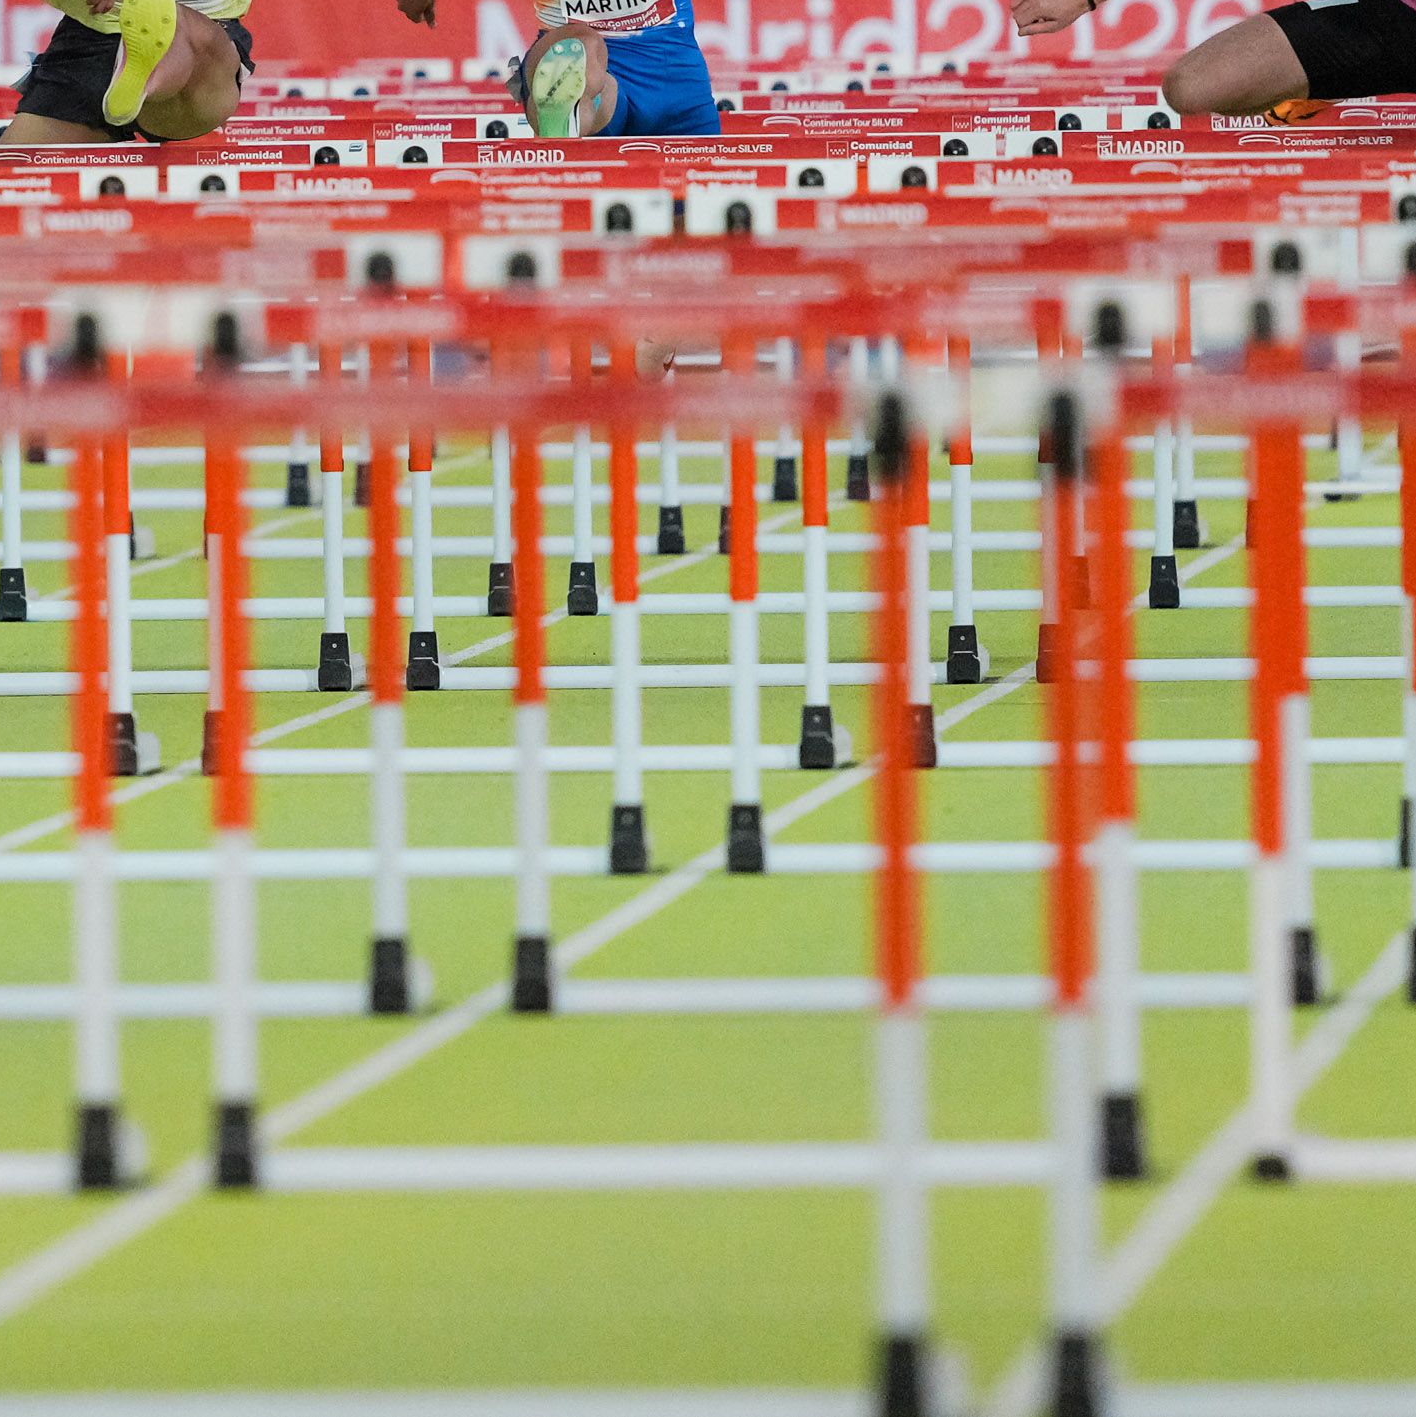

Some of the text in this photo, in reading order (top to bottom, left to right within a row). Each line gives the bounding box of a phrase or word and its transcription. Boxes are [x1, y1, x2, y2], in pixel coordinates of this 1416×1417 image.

[803, 118, 903, 128] Continental Tour SILVER
[974, 116, 1030, 124] Comunidad
[1229, 116, 1265, 127] MAD
[224, 126, 324, 135] Continental Tour SILVER
[395, 123, 451, 132] Comunidad
[851, 141, 912, 150] Comunidad
[1117, 141, 1184, 155] MADRID
[1283, 137, 1393, 148] Continental Tour SILVER
[663, 144, 772, 155] Continental Tour SILVER
[34, 154, 143, 165] Continental Tour SILVER
[221, 151, 283, 160] Comunidad
[497, 149, 564, 164] MADRID
[851, 152, 912, 161] de Madrid
[996, 169, 1073, 186] MADRID
[296, 178, 373, 195] MADRID
